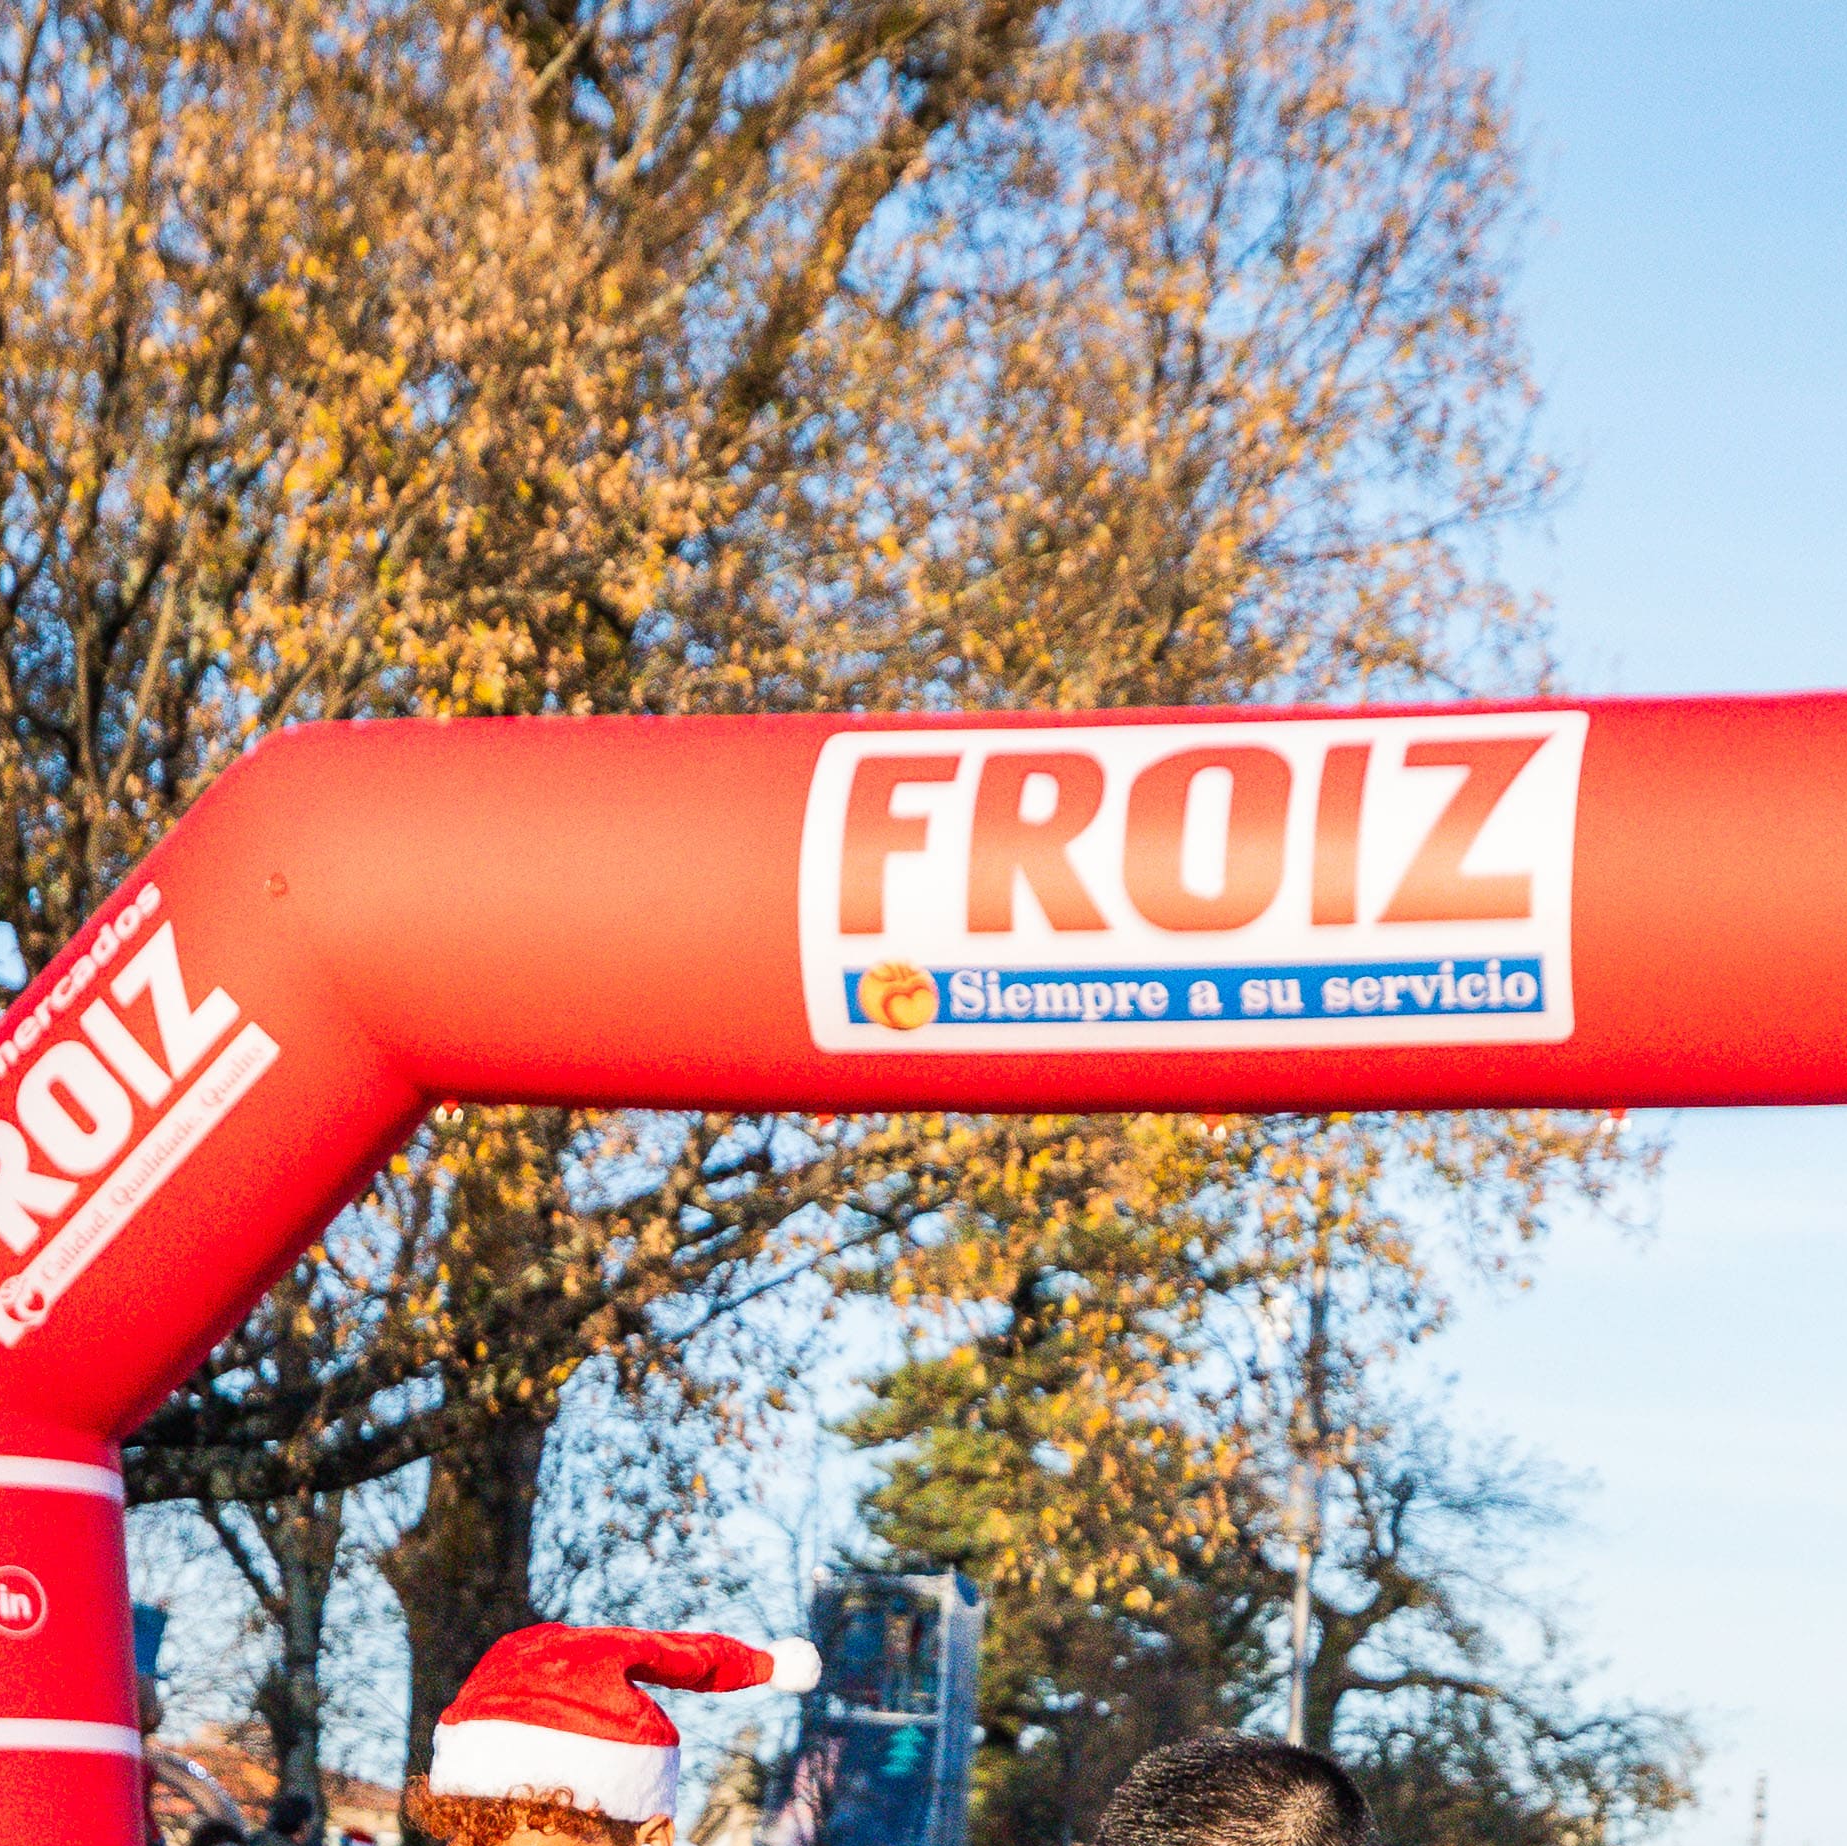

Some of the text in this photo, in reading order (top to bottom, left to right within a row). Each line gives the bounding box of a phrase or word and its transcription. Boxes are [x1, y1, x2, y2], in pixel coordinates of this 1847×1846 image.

[840, 731, 1556, 935] FROIZ
[951, 958, 1538, 1021] Siempre a su servicio
